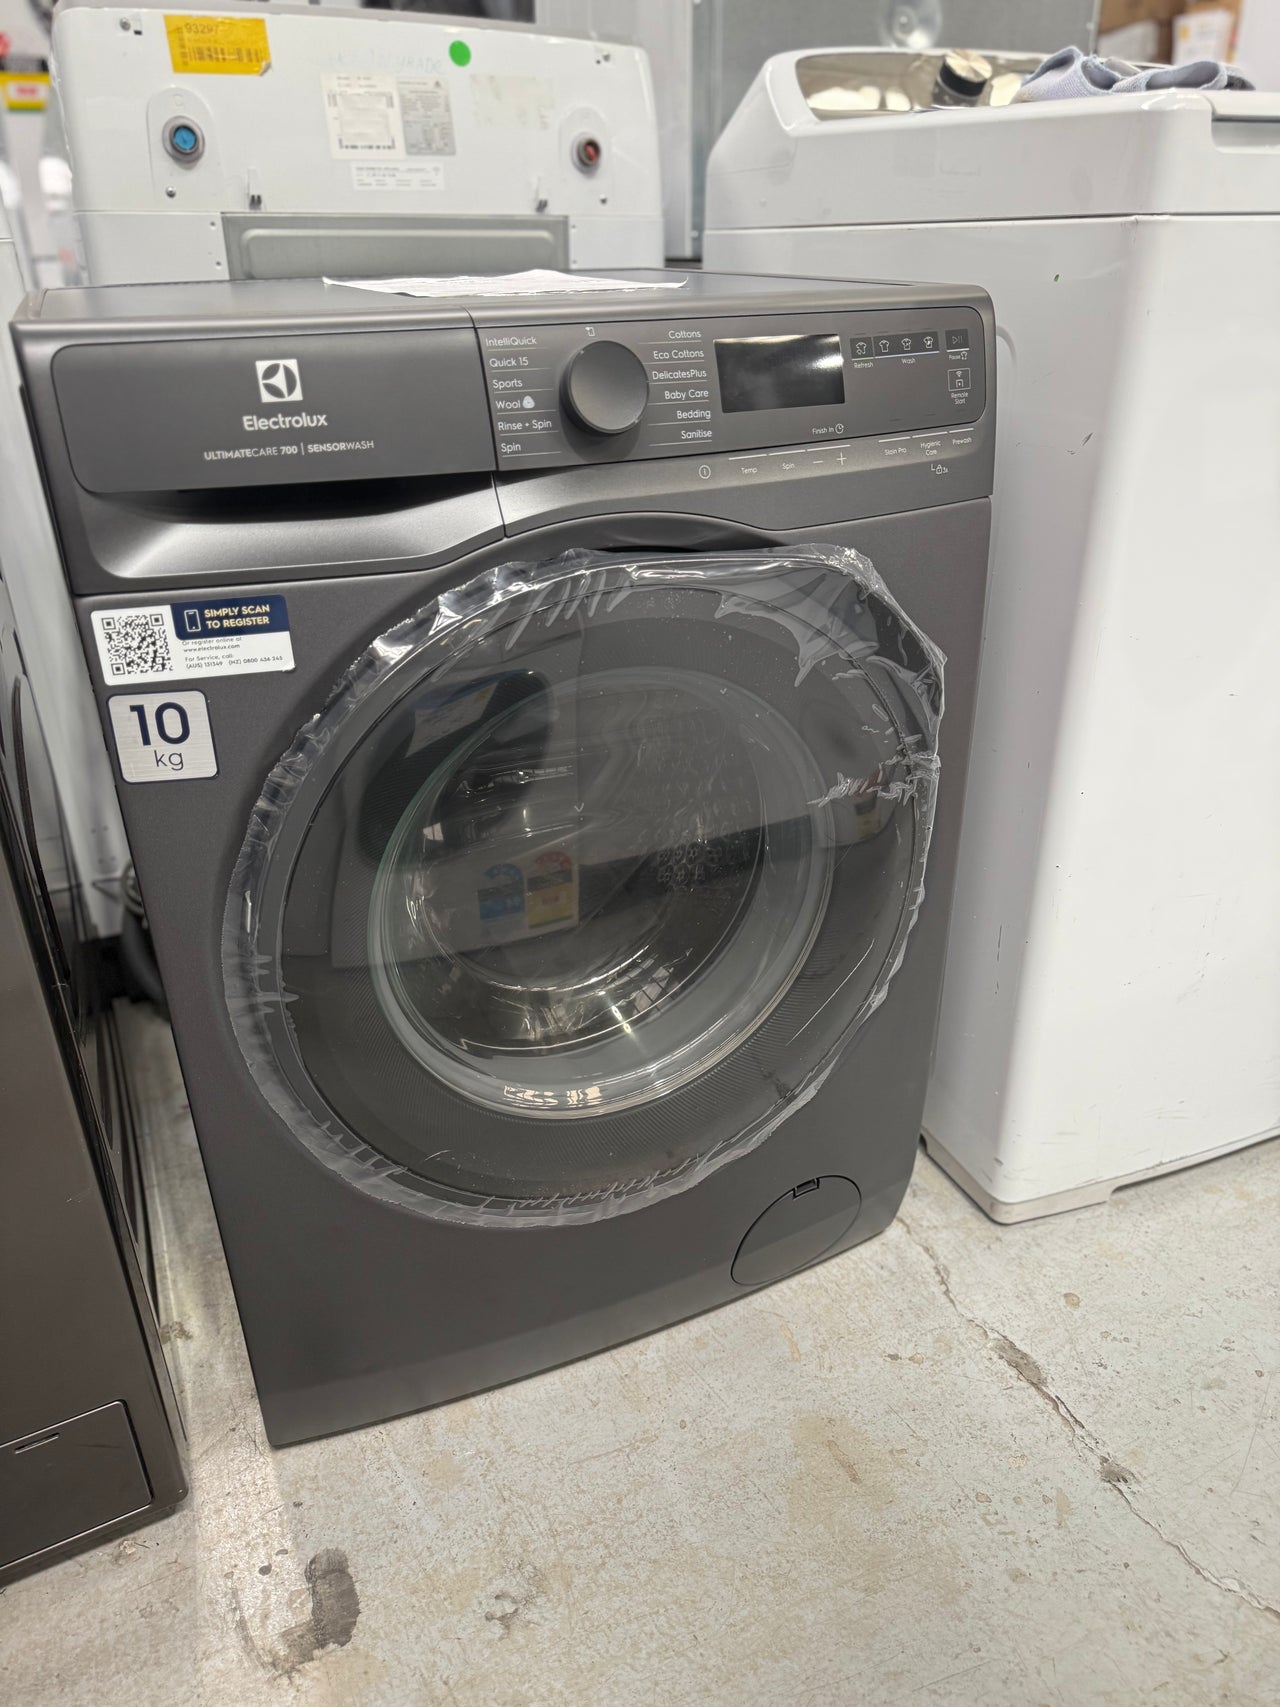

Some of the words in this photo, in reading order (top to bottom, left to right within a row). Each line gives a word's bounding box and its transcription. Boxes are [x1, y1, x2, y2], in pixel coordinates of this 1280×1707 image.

[668, 330, 702, 340] Cottons
[485, 336, 538, 347] IntelliQuick
[653, 350, 670, 360] Eco
[671, 349, 705, 359] Cottons
[489, 358, 518, 368] Quick
[519, 356, 529, 366] 15
[853, 361, 874, 369] Refresh
[652, 368, 707, 380] DelicatesPlus
[492, 378, 523, 390] Sports
[664, 390, 687, 401] Baby
[688, 389, 709, 398] Care
[950, 391, 969, 399] Remote
[495, 399, 521, 410] Wool
[676, 409, 711, 420] Bedding
[242, 411, 328, 432] Electrolux
[497, 421, 523, 431] Rinse
[532, 419, 552, 430] Spin
[681, 429, 713, 440] Sanitise
[812, 427, 828, 435] Finish
[920, 440, 941, 449] Hygienic
[952, 436, 972, 446] Prewash
[203, 446, 279, 461] ULTIMATECARE
[281, 445, 298, 455] 700
[307, 440, 375, 454] SENSORWASH
[501, 442, 522, 454] Spin
[884, 448, 898, 456] Stain
[740, 466, 758, 475] Temp
[782, 462, 796, 471] Spin
[203, 606, 240, 619] SIMPLY
[241, 604, 271, 615] SCAN
[205, 619, 221, 630] TO
[223, 616, 270, 628] REGISTER
[183, 643, 241, 653] www.electrolux.com
[191, 639, 215, 648] register
[196, 654, 220, 662] Service,
[228, 657, 242, 666] (NZ)
[186, 661, 203, 670] (AUS)
[204, 660, 224, 669] 131349
[129, 701, 191, 747] 10
[153, 749, 184, 771] kg
